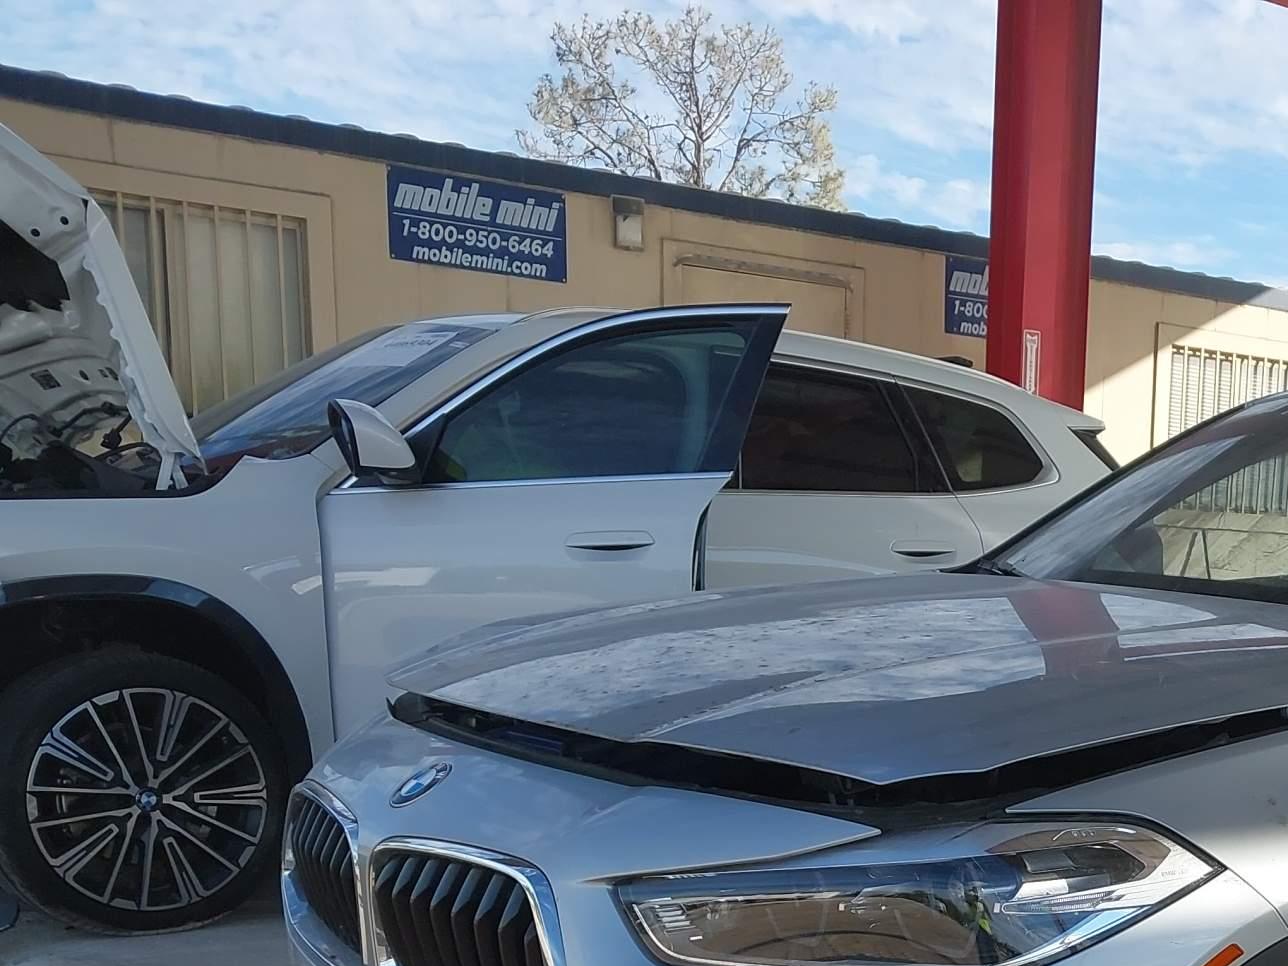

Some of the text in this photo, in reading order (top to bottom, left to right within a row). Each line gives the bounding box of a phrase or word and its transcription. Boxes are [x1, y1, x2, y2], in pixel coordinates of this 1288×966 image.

[393, 178, 561, 232] mobile mini
[402, 218, 554, 259] 1-800-950-6464
[412, 246, 547, 278] mobilemini.com
